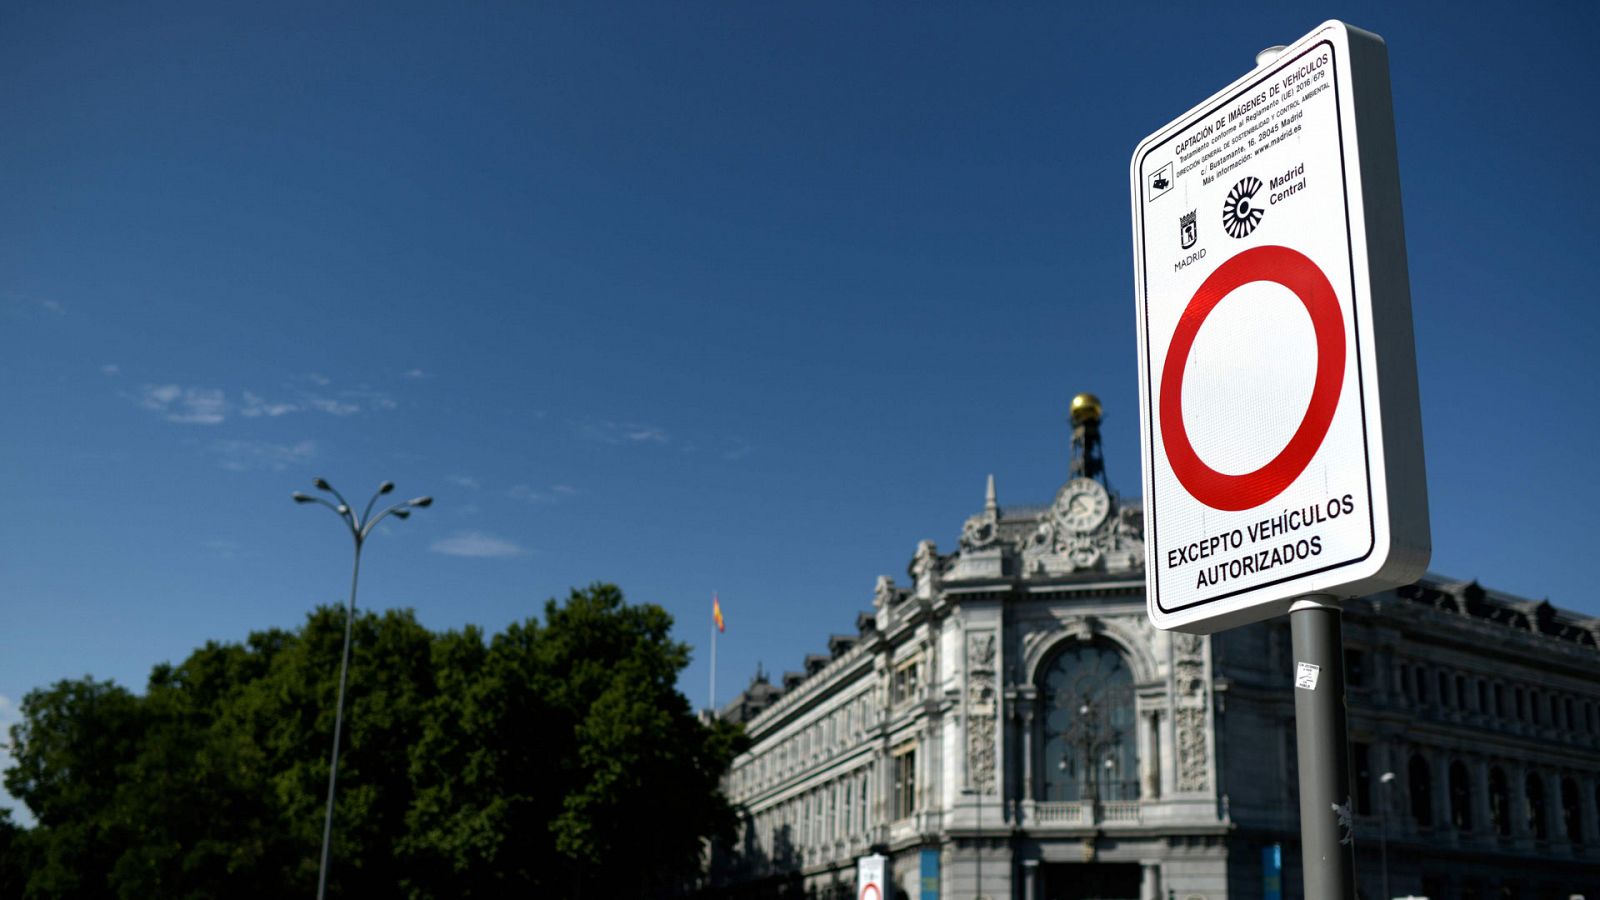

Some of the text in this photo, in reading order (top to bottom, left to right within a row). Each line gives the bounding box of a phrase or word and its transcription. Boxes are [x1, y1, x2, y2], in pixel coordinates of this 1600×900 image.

[1176, 53, 1328, 155] CAPTACIÓN DE IMÁGENES DE VEHÍCULOS
[1176, 161, 1200, 178] DIRECCIÓN
[1201, 148, 1222, 163] GENERAL
[1224, 141, 1230, 149] DE
[1276, 100, 1300, 118] CONTROL
[1302, 82, 1330, 103] AMBIENTAL
[1179, 142, 1209, 163] Tratamiento
[1211, 126, 1236, 144] conforme
[1239, 120, 1244, 128] al
[1246, 100, 1279, 123] Reglamento
[1281, 89, 1294, 103] (UE)
[1258, 124, 1279, 141] 28045
[1281, 110, 1303, 128] Madrid
[1202, 176, 1214, 186] Más
[1254, 124, 1302, 155] www.madrid.es
[1270, 163, 1304, 191] Madrid
[1270, 178, 1306, 205] Central
[1174, 248, 1207, 272] MADRID
[1168, 494, 1354, 568] EXCEPTO VEHÍCULOS
[1197, 535, 1322, 589] AUTORIZADOS
